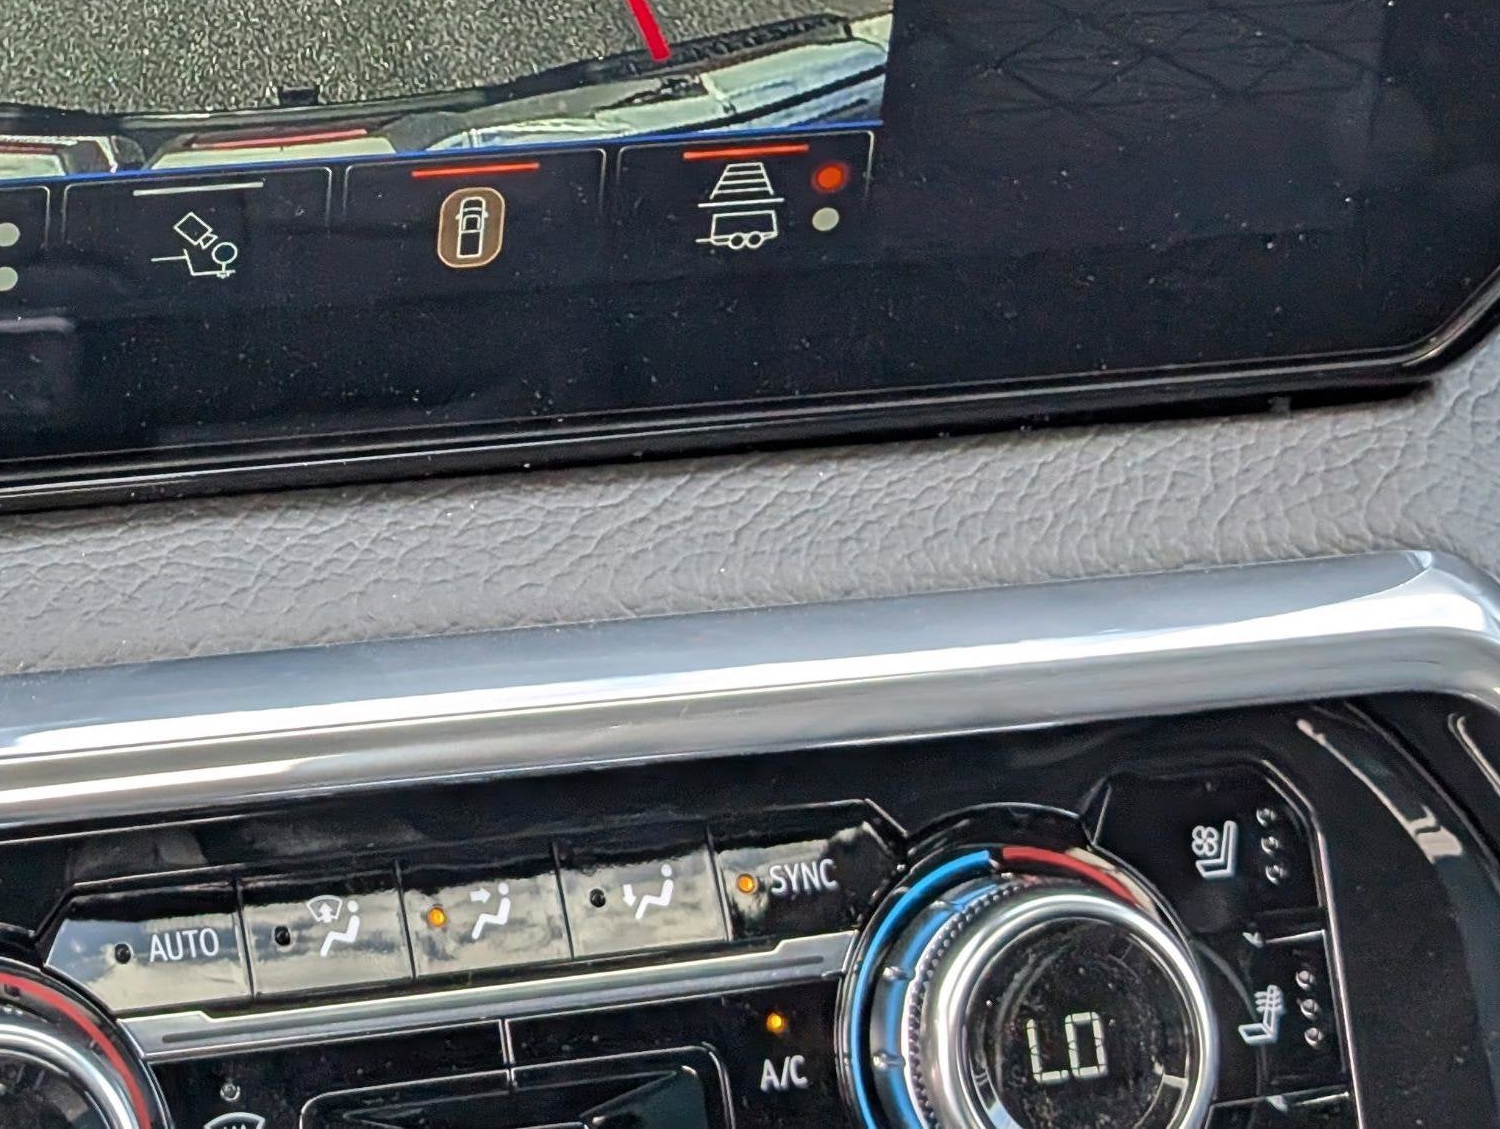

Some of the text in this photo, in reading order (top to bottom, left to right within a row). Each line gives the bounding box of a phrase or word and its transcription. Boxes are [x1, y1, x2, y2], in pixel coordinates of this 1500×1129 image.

[769, 858, 838, 894] SYNC
[149, 927, 220, 963] AUTO
[1026, 1012, 1108, 1084] LO
[759, 1055, 807, 1091] A/C
